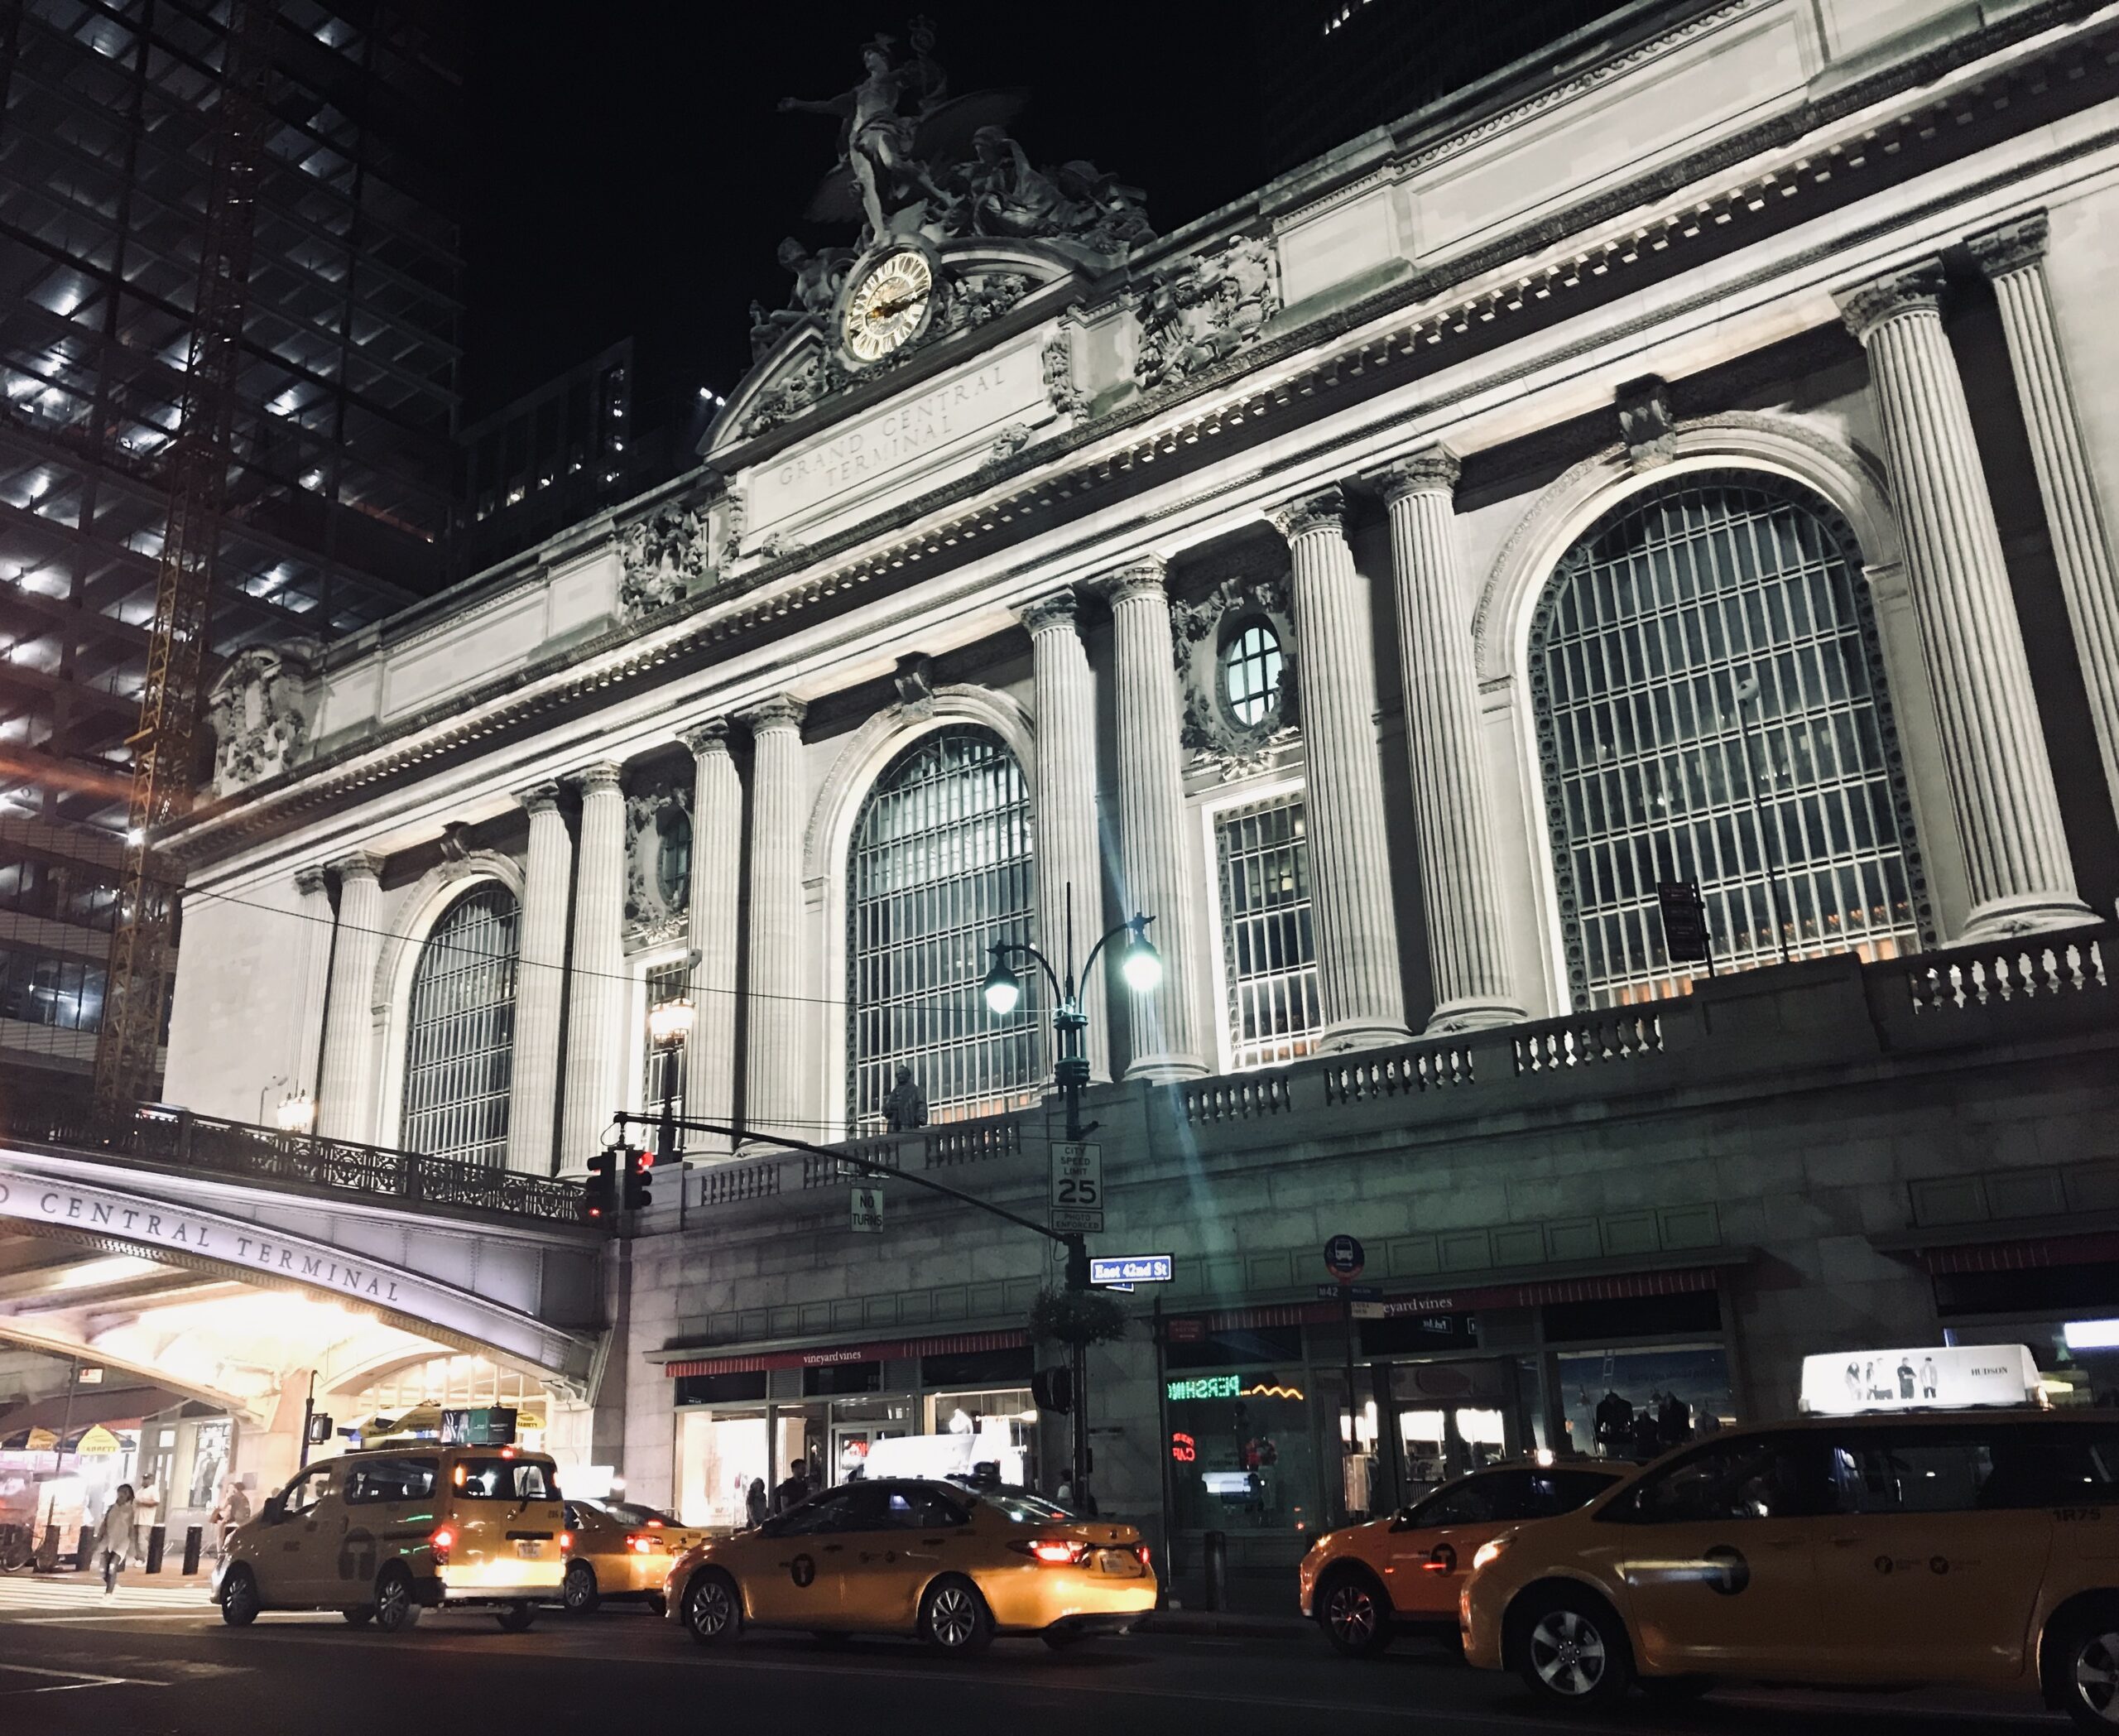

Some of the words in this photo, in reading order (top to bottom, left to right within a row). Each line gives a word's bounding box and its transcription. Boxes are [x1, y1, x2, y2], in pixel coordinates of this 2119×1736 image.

[780, 434, 863, 485] GRAND
[882, 367, 1004, 436] CENTRAL
[826, 416, 952, 486] TERMINAL
[1064, 1146, 1086, 1155] CITY
[1060, 1157, 1090, 1166] SPEED
[1064, 1167, 1088, 1176] LIMIT
[1058, 1179, 1097, 1204] 25
[860, 1195, 874, 1209] NO
[853, 1214, 882, 1226] TURNS
[1064, 1213, 1091, 1221] PHOTO
[1056, 1220, 1099, 1229] ENFORCED
[40, 1193, 209, 1248] CENTRAL
[238, 1238, 398, 1302] TERMINAL
[1094, 1263, 1121, 1279] East
[1122, 1262, 1151, 1277] 42nd
[1154, 1261, 1167, 1276] St
[1383, 1298, 1418, 1316] eyard
[1420, 1297, 1453, 1310] vines
[803, 1351, 838, 1365] vineyard
[839, 1350, 862, 1361] vines
[1971, 1367, 2008, 1376] HUDSON
